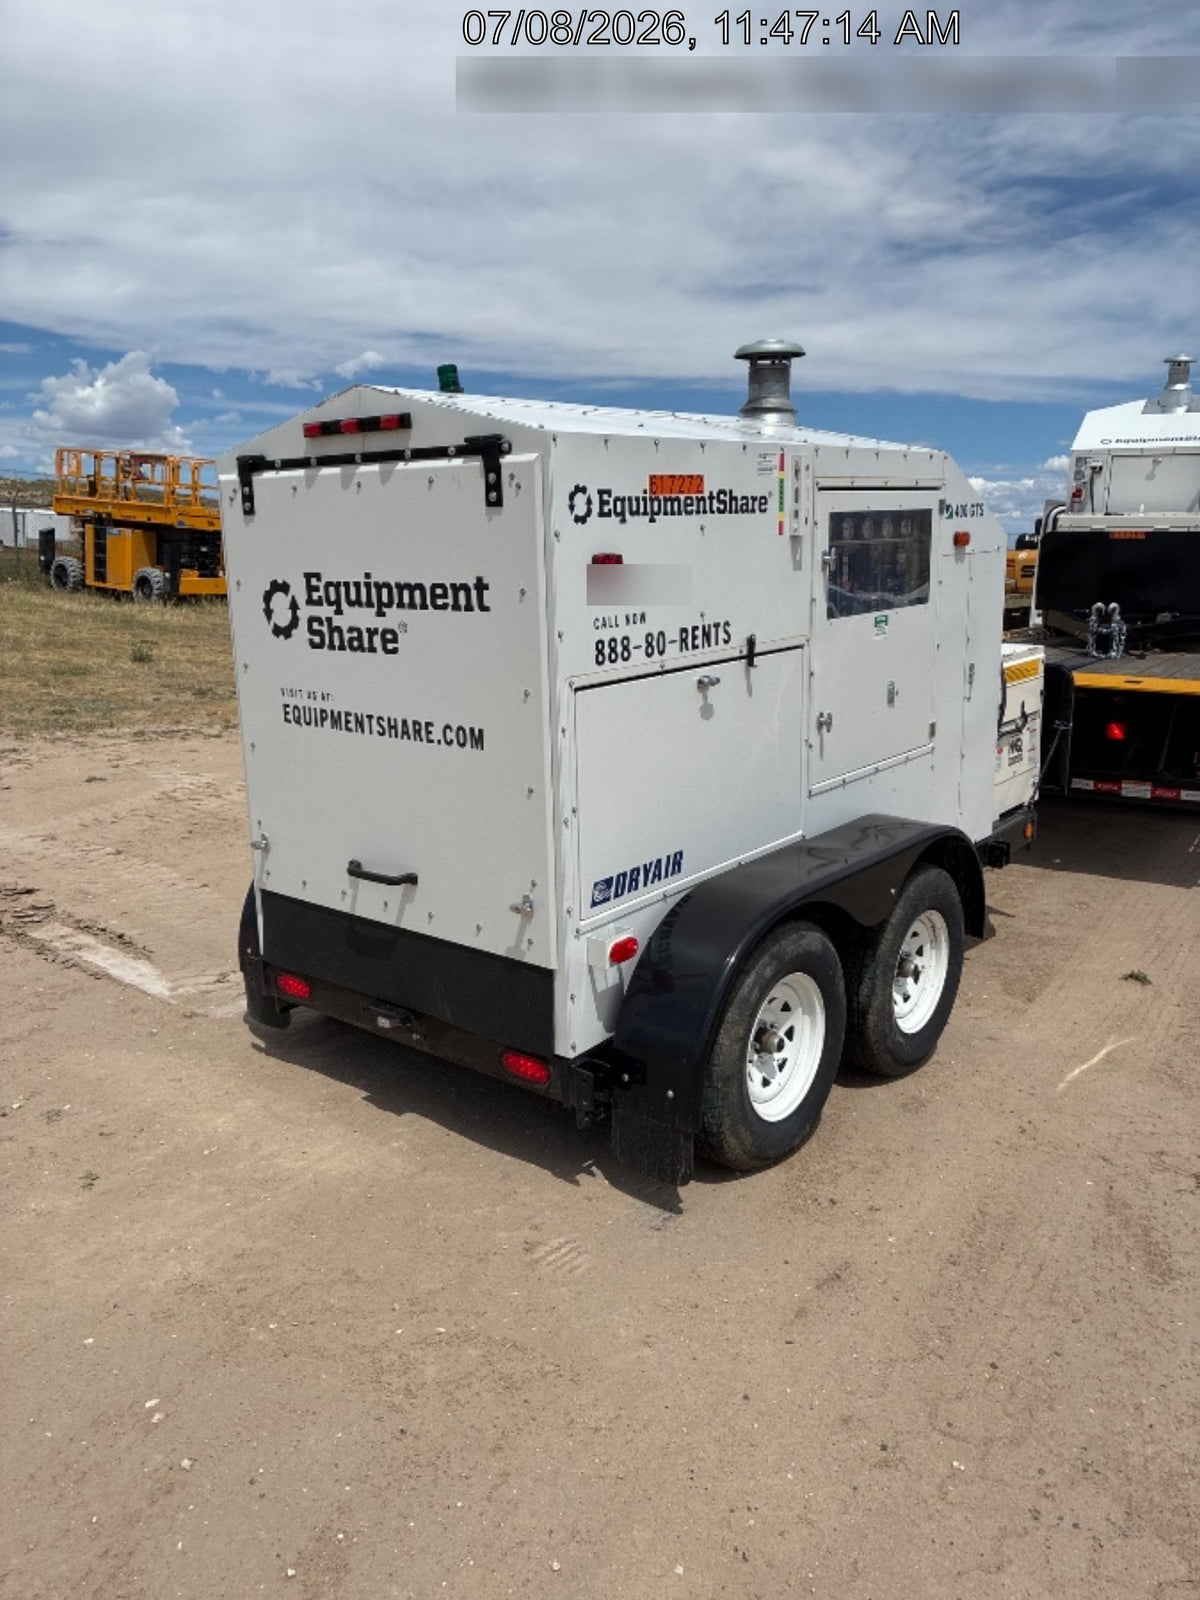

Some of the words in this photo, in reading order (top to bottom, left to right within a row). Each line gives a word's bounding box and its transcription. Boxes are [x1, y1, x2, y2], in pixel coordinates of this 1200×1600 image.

[597, 488, 769, 523] EquipmentShare
[304, 571, 491, 617] Equipment
[593, 614, 620, 631] CALL
[625, 610, 647, 626] NOW
[594, 620, 731, 666] 888-80-RENTS
[280, 687, 303, 700] VISIT
[306, 690, 317, 701] US
[282, 703, 485, 750] EQUIPMENTSHARE.COM
[613, 850, 683, 899] DRYAIR
